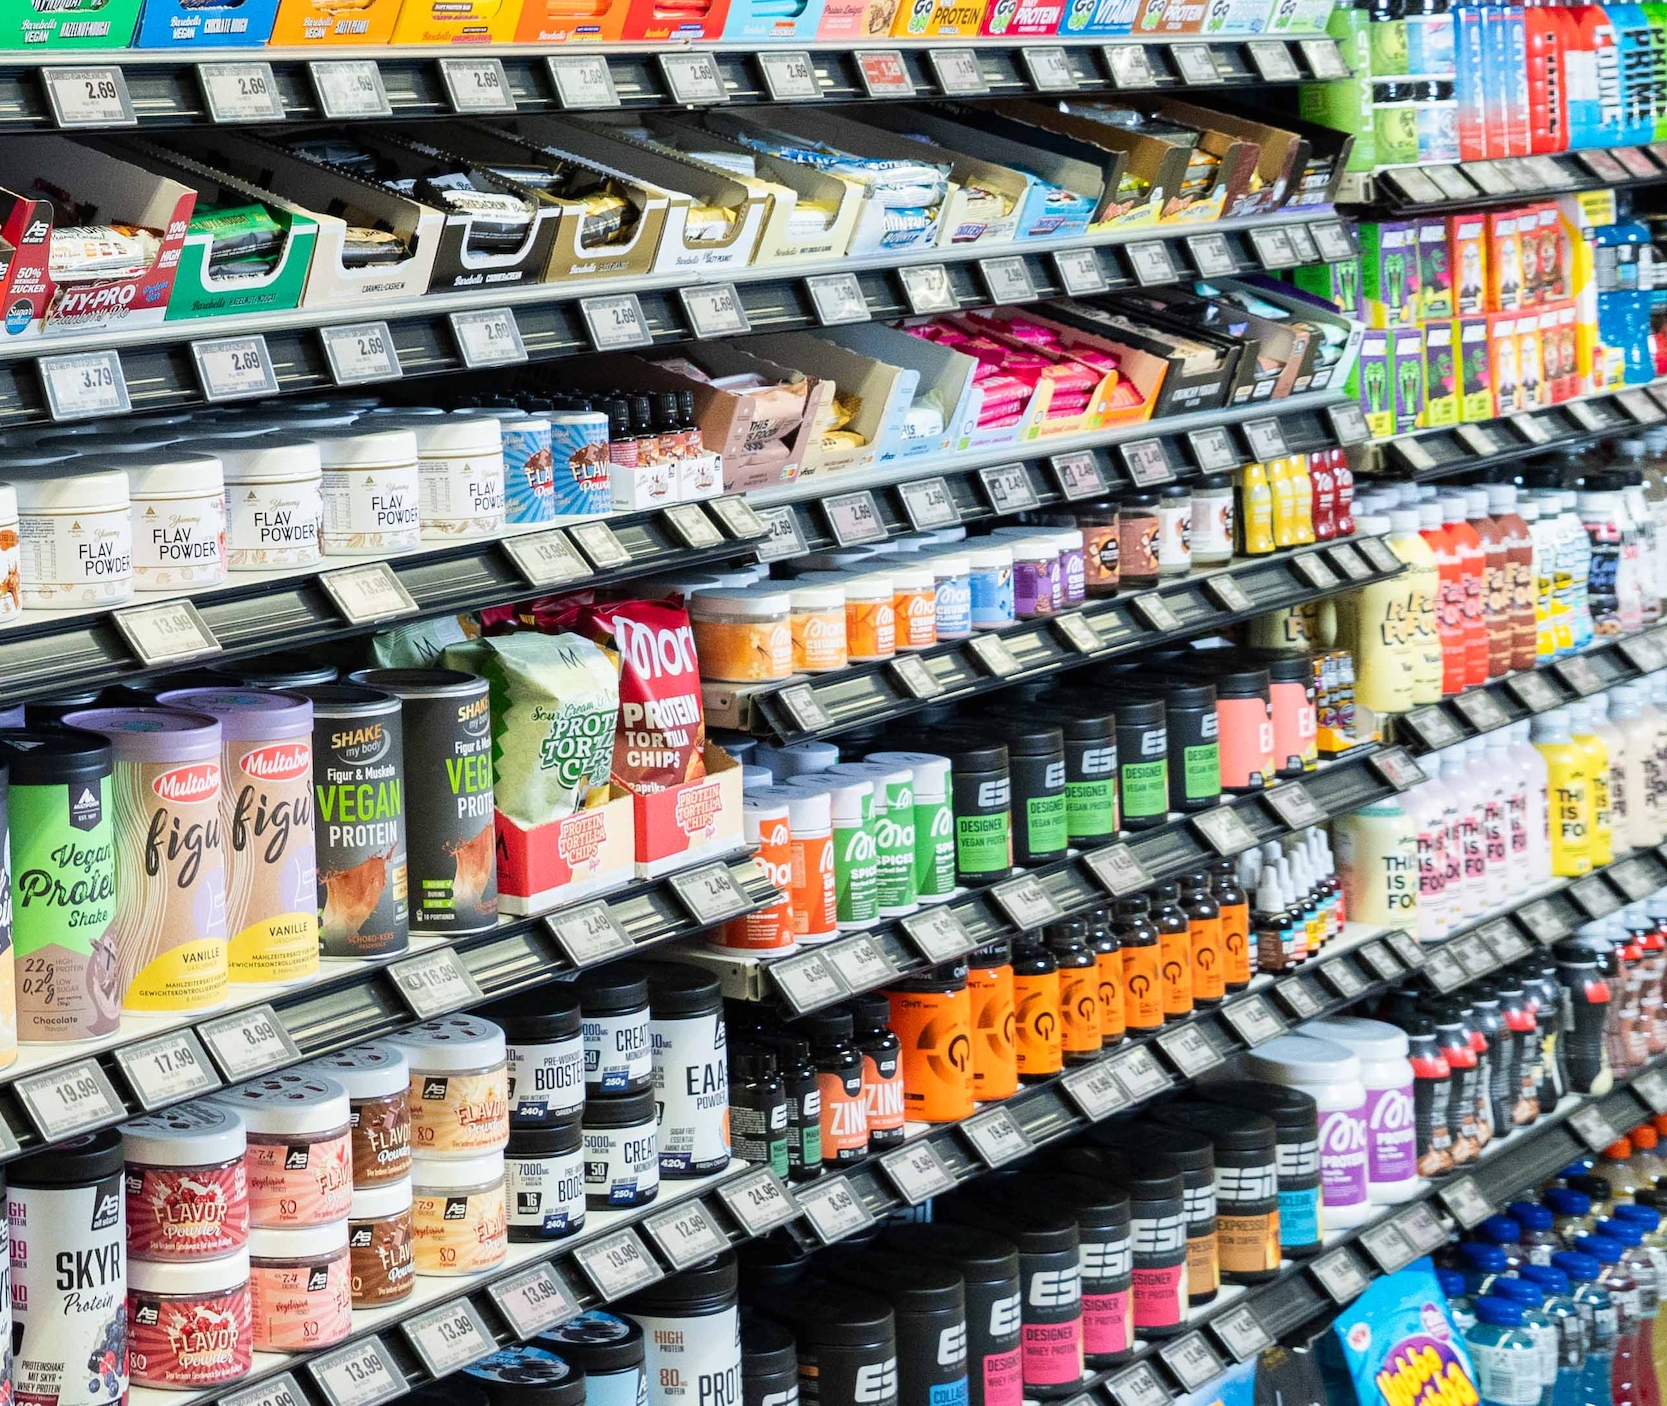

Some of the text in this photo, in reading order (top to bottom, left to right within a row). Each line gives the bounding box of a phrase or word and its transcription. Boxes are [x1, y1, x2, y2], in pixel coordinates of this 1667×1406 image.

[935, 6, 981, 25] PROTEIN
[86, 81, 116, 99] 2.69
[62, 284, 136, 309] HY-PRO
[358, 338, 384, 356] 2.69
[82, 369, 111, 388] 3.79
[254, 512, 291, 527] FLAV
[260, 525, 316, 543] POWDER
[624, 696, 700, 729] PROTEIN
[332, 728, 381, 748] SHAKE
[626, 731, 688, 747] TORTILLA
[627, 751, 680, 768] CHIPS
[318, 780, 401, 822] VEGAN
[330, 821, 397, 847] PROTEIN
[961, 818, 1002, 832] DESIGNER
[1387, 876, 1405, 889] IS
[244, 1022, 275, 1044] 8.99
[154, 1051, 193, 1071] 17.99
[56, 1078, 99, 1106] 19.99
[520, 1106, 543, 1117] 240g
[154, 1201, 226, 1224] FLAVOR
[56, 1242, 121, 1288] SKYR
